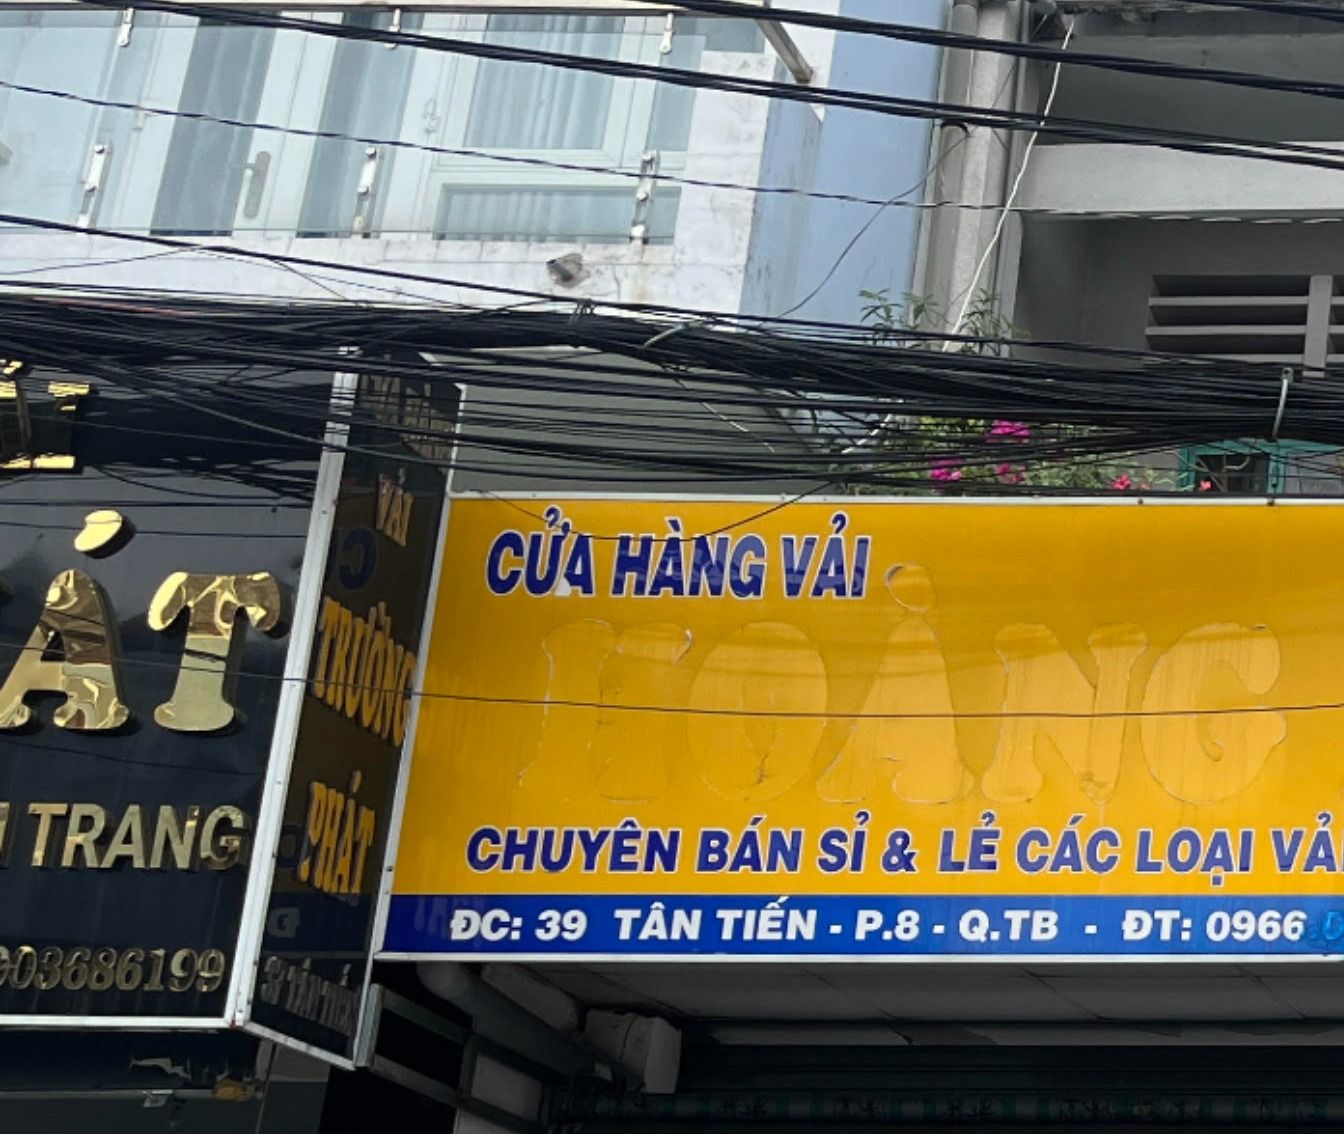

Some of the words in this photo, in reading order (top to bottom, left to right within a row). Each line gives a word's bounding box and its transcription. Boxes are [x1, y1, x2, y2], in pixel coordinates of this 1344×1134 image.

[486, 506, 596, 599] CỬA
[611, 515, 769, 599] HÀNG
[781, 512, 872, 599] VẢI
[28, 802, 245, 870] TRANG
[466, 817, 680, 874] CHUYÊN
[698, 815, 801, 874] BÁN
[817, 811, 871, 874] SỈ
[937, 811, 1000, 874] LẺ
[1015, 814, 1122, 874] CÁC
[1134, 828, 1254, 886] LOẠI
[535, 909, 587, 942] 39
[613, 901, 708, 942] TÂN
[716, 896, 818, 942] TIẾN
[854, 909, 920, 942] P.8
[958, 908, 1059, 945] Q.TB
[1121, 909, 1193, 941] ĐT:
